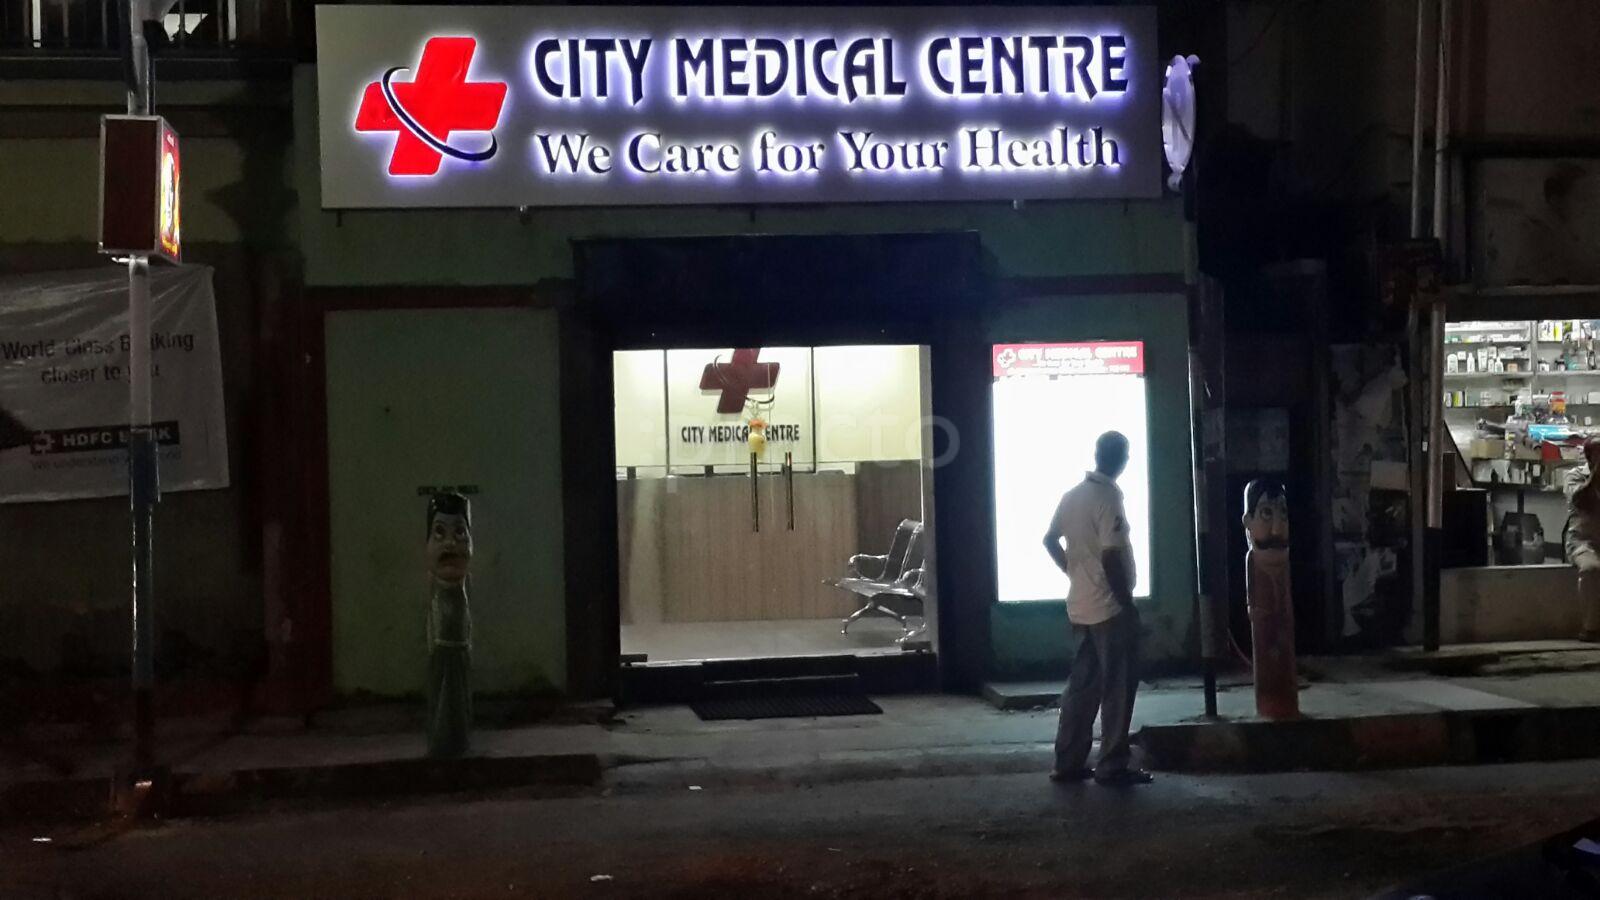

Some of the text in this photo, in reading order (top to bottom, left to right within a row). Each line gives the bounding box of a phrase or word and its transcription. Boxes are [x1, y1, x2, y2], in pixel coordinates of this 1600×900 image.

[534, 35, 1129, 106] CITY MEDICAL CENTRE
[535, 126, 1121, 173] We Care for Your Health
[119, 333, 194, 352] Bking
[104, 365, 121, 382] to
[62, 431, 113, 448] HDFC
[681, 426, 705, 443] CITY
[764, 424, 800, 441] ENTRE
